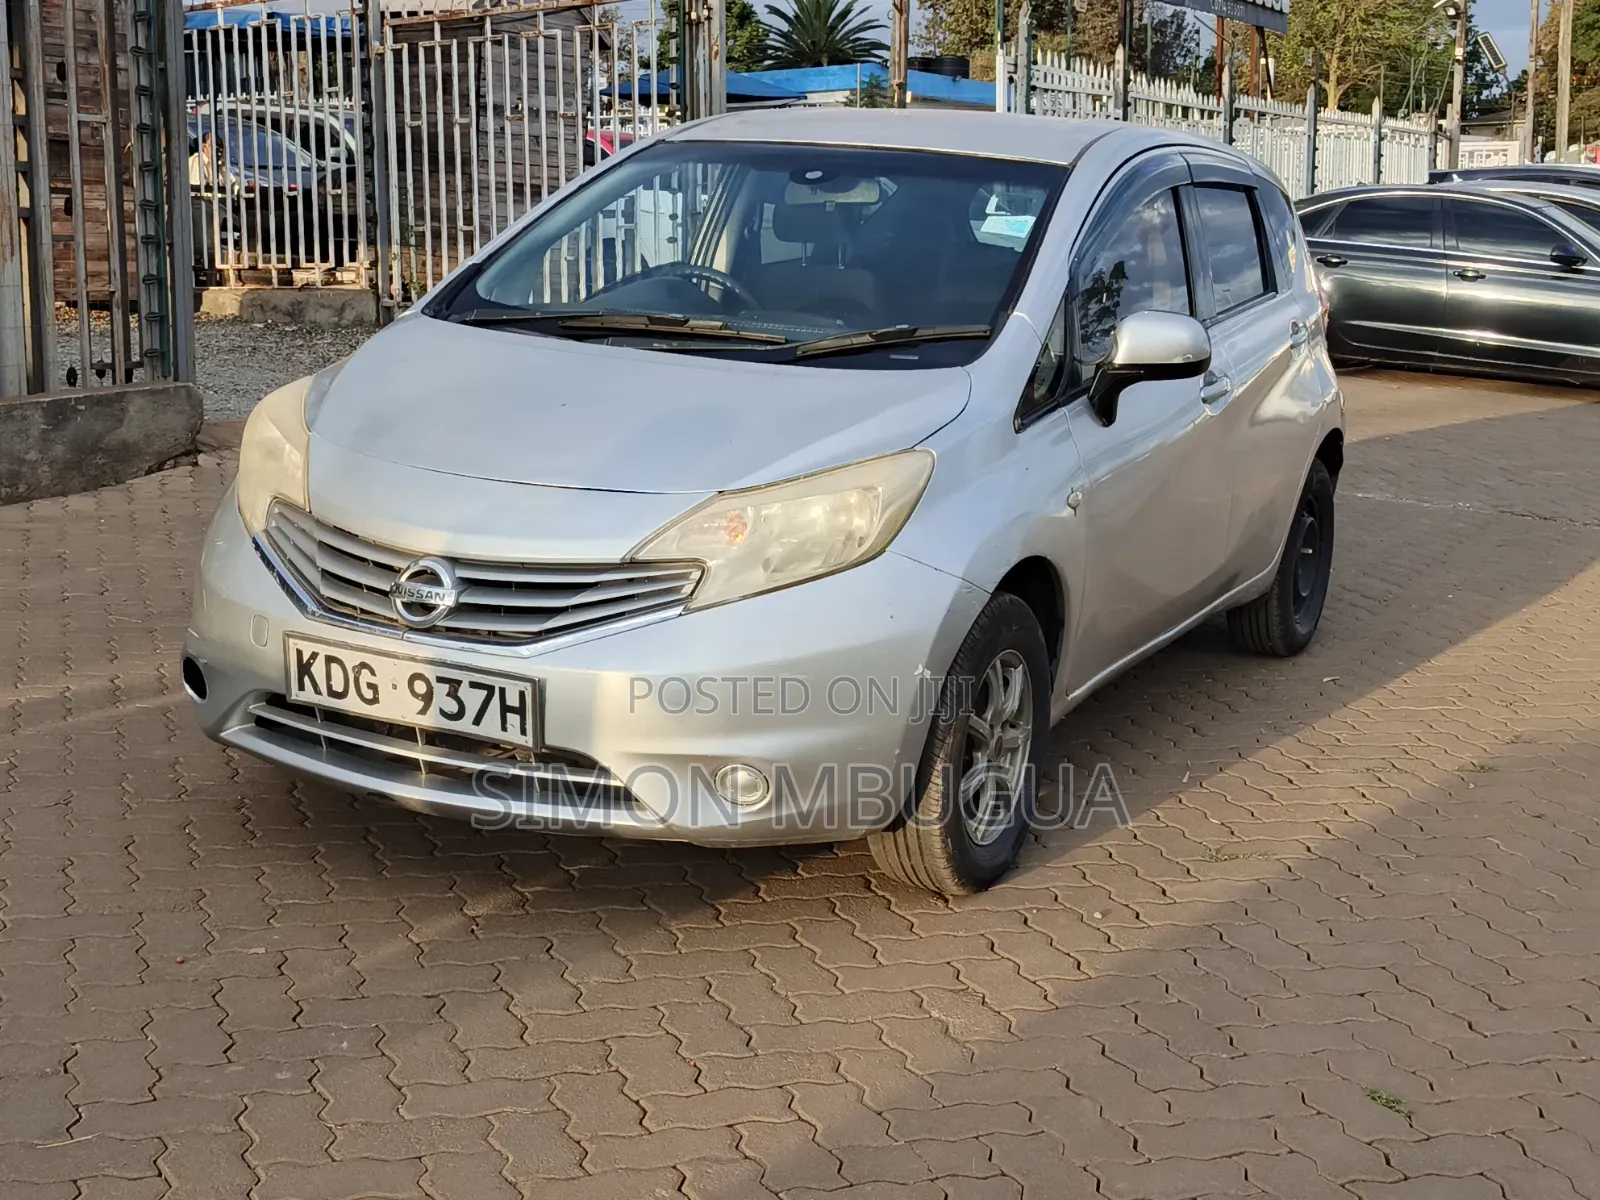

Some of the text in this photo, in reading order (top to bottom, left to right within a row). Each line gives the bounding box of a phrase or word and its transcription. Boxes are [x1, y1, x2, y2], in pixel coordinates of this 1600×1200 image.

[395, 586, 446, 602] NISSAN
[295, 647, 528, 737] KDG 937H
